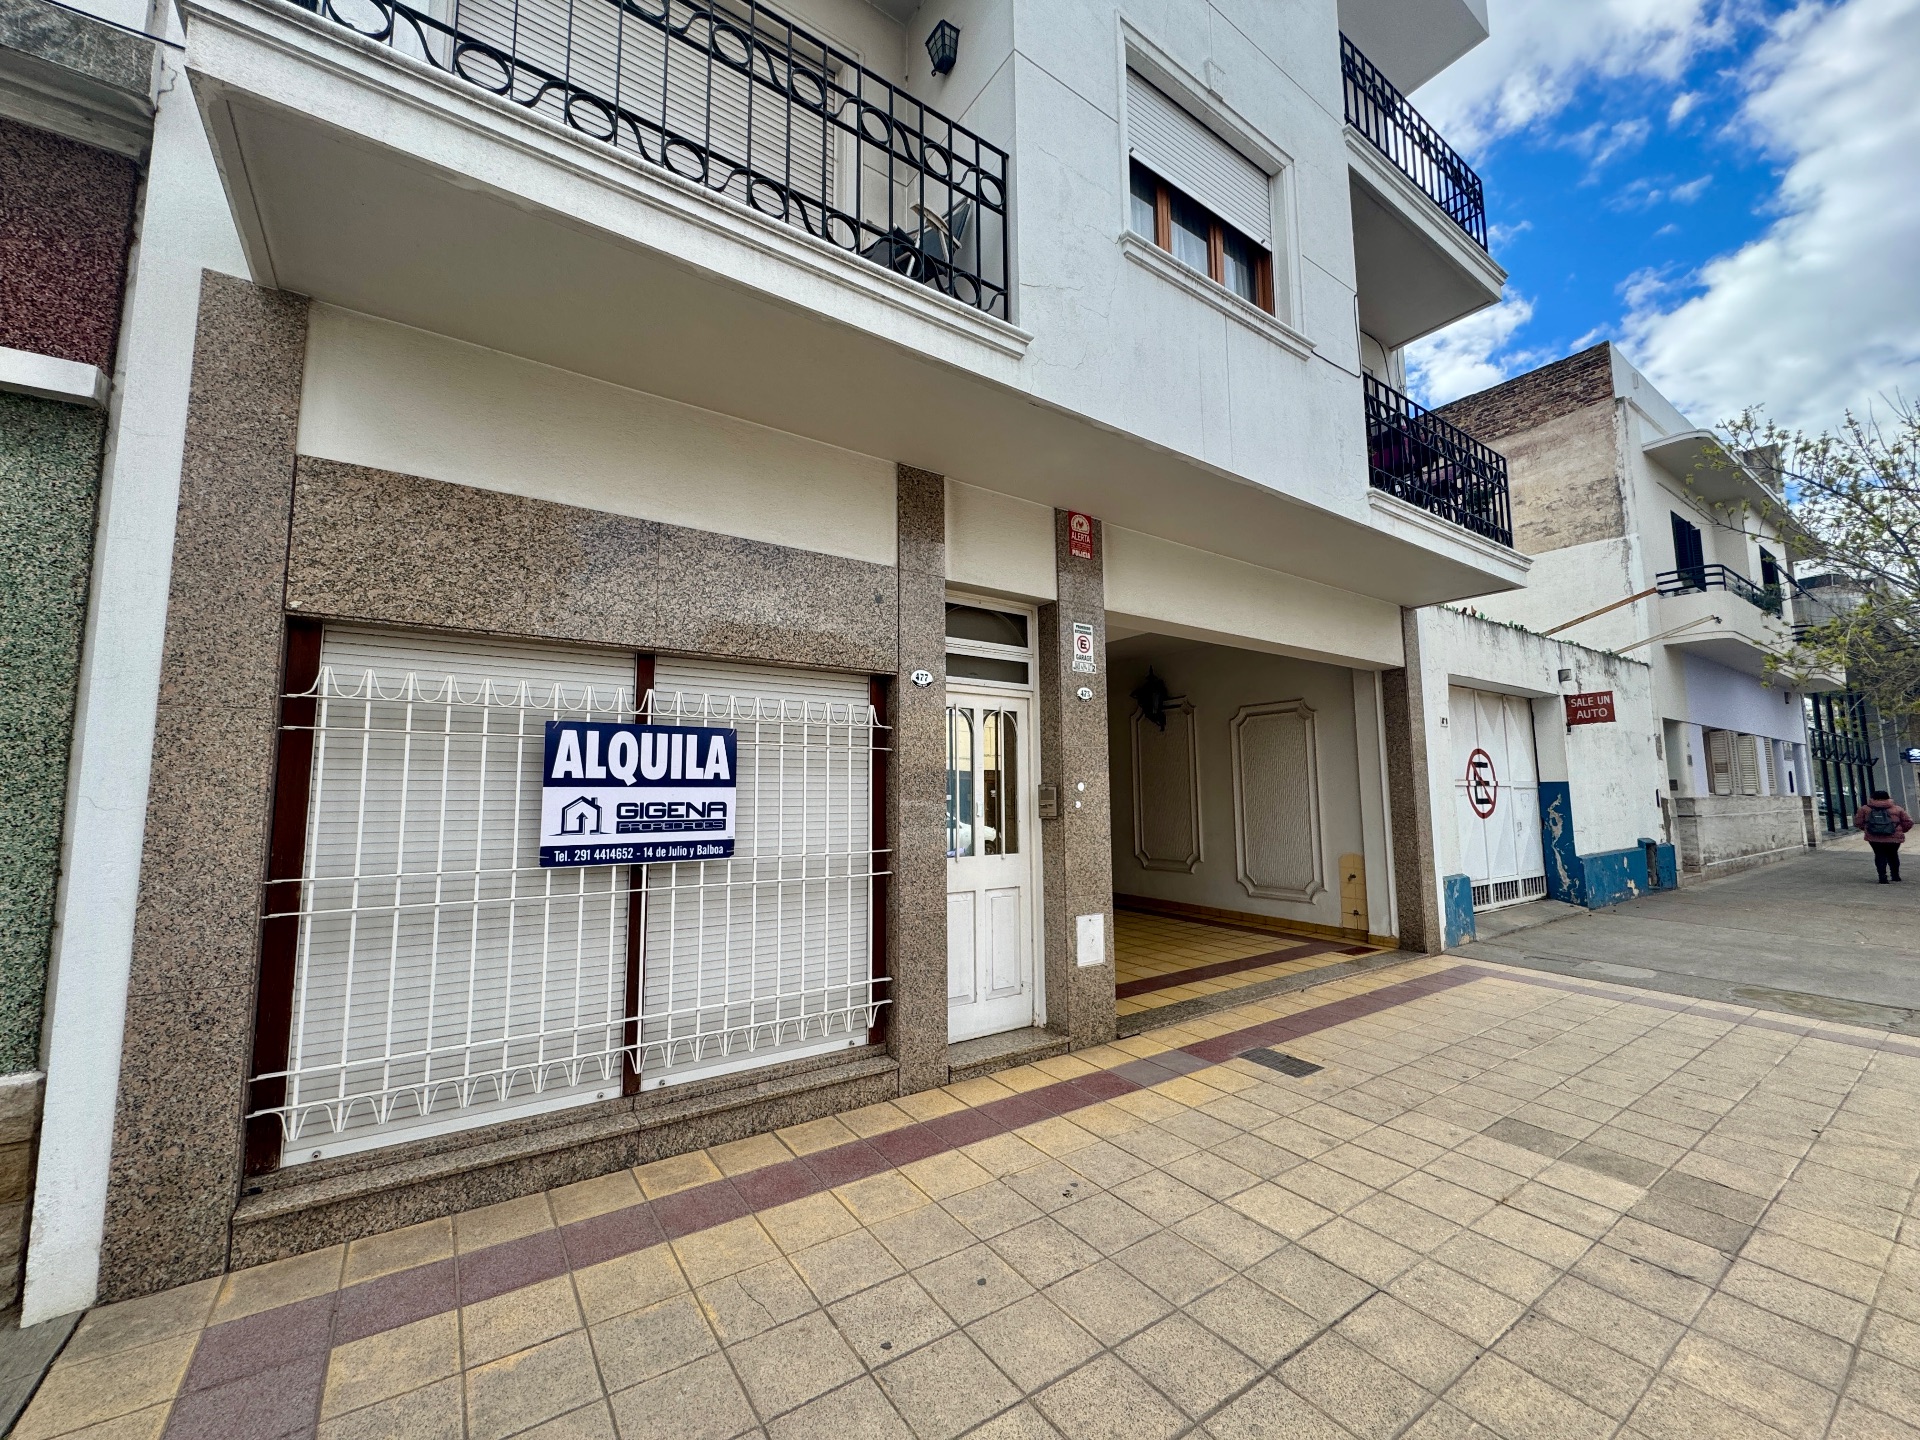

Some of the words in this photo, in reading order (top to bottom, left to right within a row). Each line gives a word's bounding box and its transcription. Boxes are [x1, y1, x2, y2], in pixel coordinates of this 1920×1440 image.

[1071, 531, 1091, 544] ALERTA
[1076, 653, 1092, 662] GARAGE
[916, 672, 928, 682] 477
[1570, 696, 1594, 708] SALE
[1597, 695, 1610, 705] UN
[1576, 707, 1608, 719] AUTO
[551, 729, 731, 786] ALQUILA
[1472, 761, 1494, 804] E
[616, 801, 727, 820] GIGENA
[618, 820, 724, 832] PROPIEDADES
[554, 850, 571, 862] Tel.
[574, 849, 591, 861] 291
[593, 847, 634, 860] 4414652
[643, 846, 654, 858] 14
[655, 846, 667, 857] de
[668, 845, 688, 857] Julio
[689, 847, 695, 858] y
[696, 844, 724, 856] Balboa
